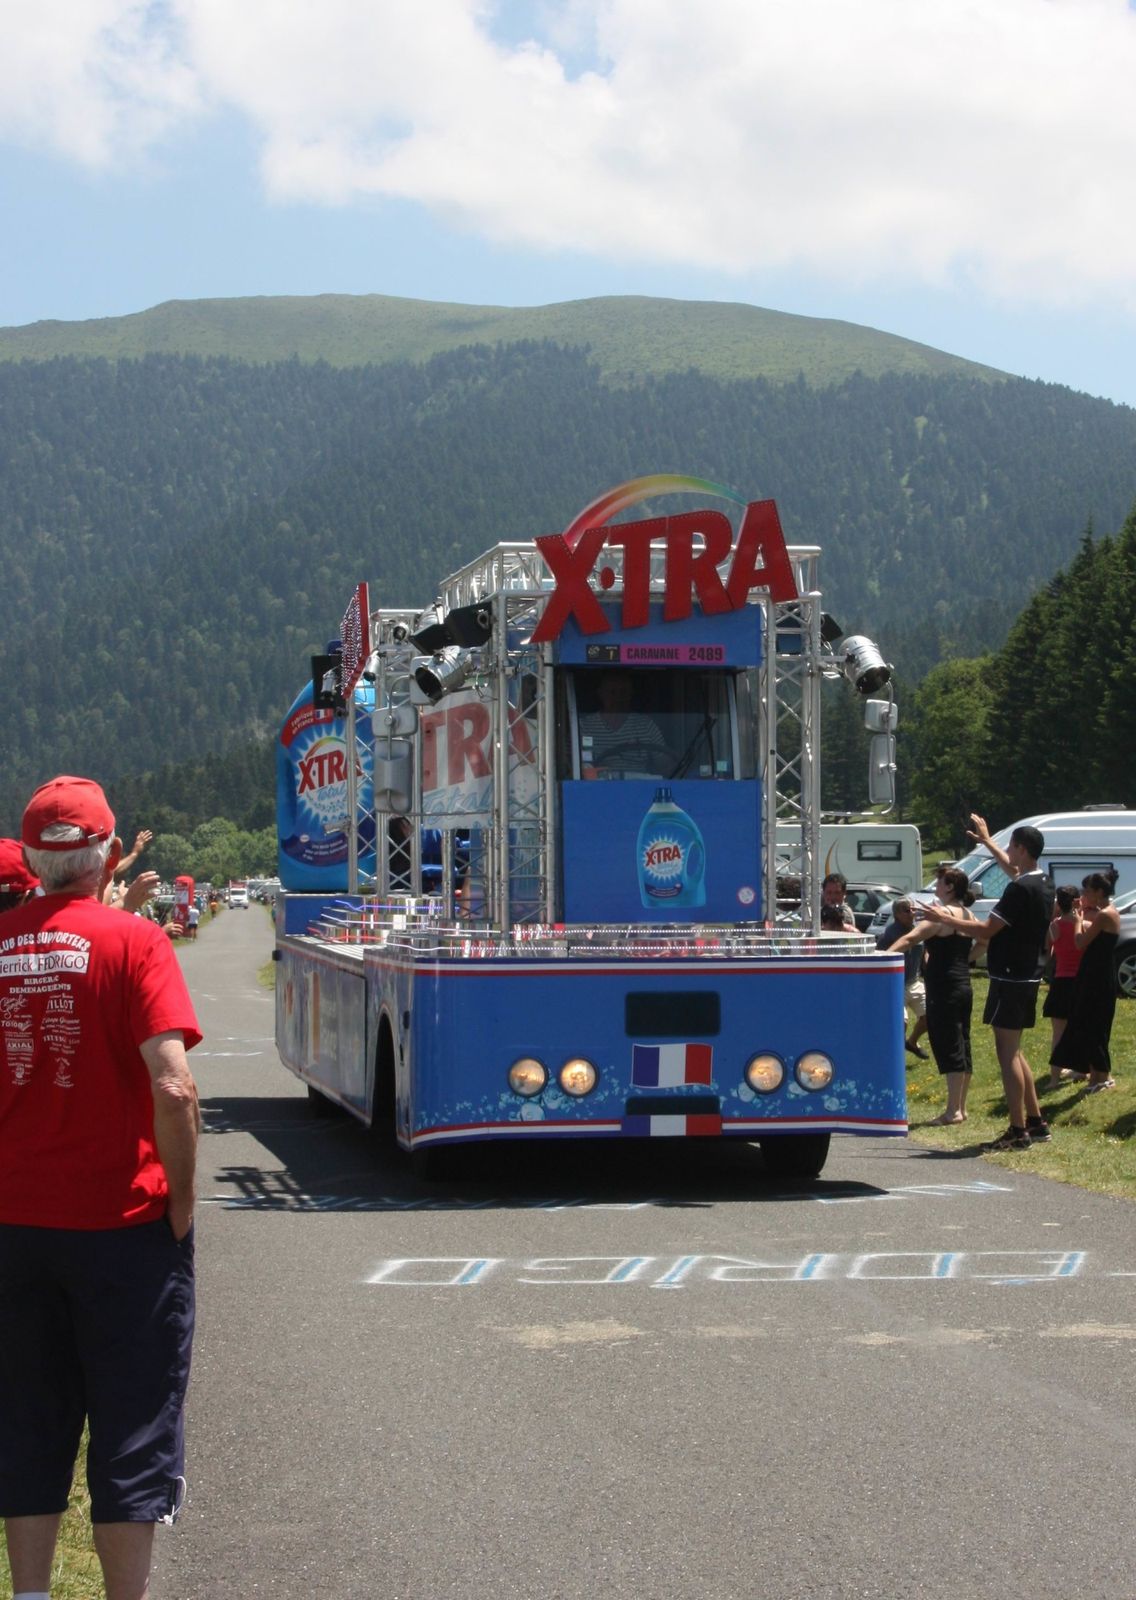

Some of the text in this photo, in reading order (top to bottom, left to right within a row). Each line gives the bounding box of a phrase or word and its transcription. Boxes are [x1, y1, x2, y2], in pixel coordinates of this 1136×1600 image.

[627, 647, 680, 660] CARAVANE
[689, 647, 722, 661] 2489
[17, 933, 35, 947] DES
[0, 957, 33, 974] ierrick
